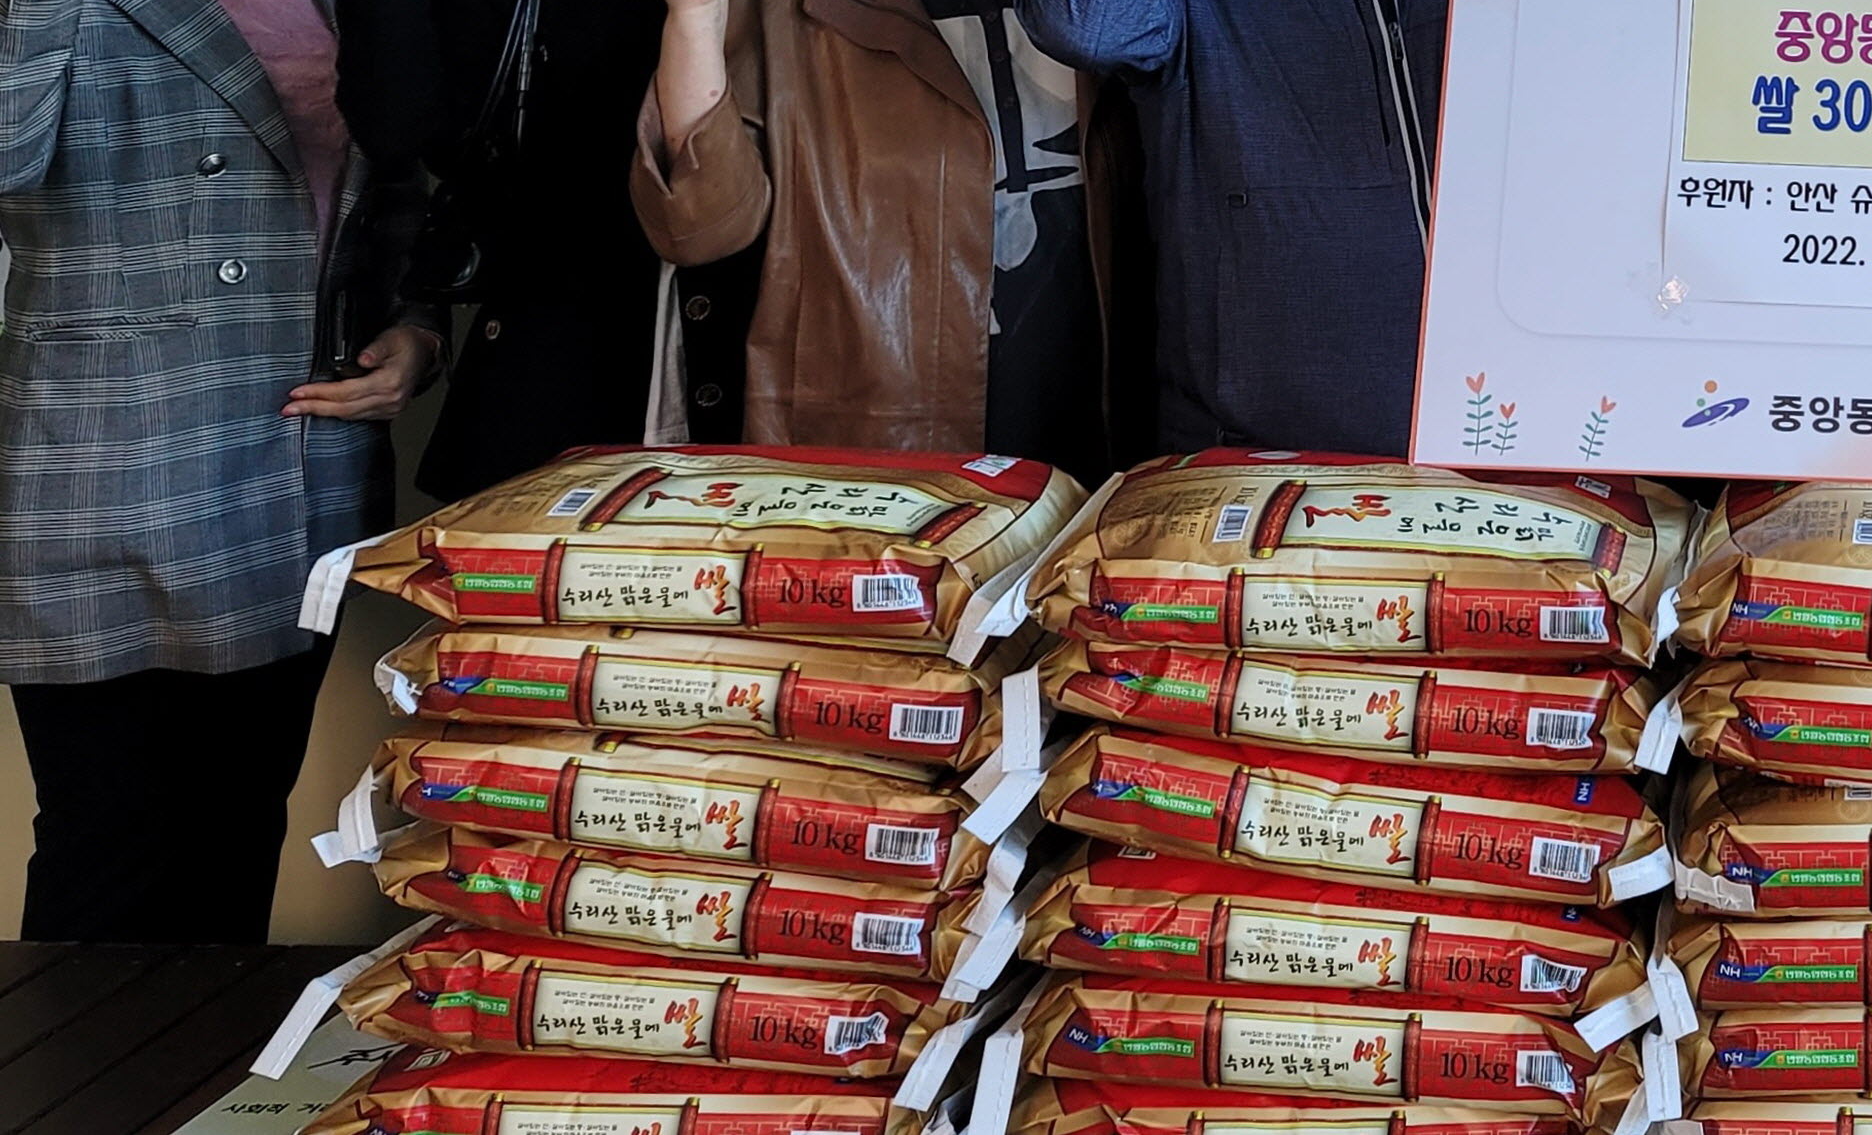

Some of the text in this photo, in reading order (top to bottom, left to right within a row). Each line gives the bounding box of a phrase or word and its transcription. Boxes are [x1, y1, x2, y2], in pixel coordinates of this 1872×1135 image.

[1752, 76, 1800, 135] 쌀
[1676, 176, 1753, 210] 후원자
[1787, 181, 1838, 212] 안산
[1783, 234, 1865, 266] 2022.
[561, 586, 614, 608] 수리산
[695, 565, 738, 616] 쌀
[1247, 616, 1299, 637] 수리산
[1377, 597, 1420, 643] 쌀
[574, 810, 628, 832] 수리산
[708, 801, 748, 848] 쌀
[1242, 822, 1291, 845] 수리산
[1370, 815, 1410, 863] 쌀
[1732, 865, 1752, 880] NH
[1720, 964, 1741, 978] NH
[538, 1014, 586, 1035] 수리산
[665, 998, 706, 1048] 쌀
[1068, 1027, 1089, 1044] NH
[1224, 1054, 1276, 1074] 수리산
[1353, 1039, 1396, 1086] 쌀
